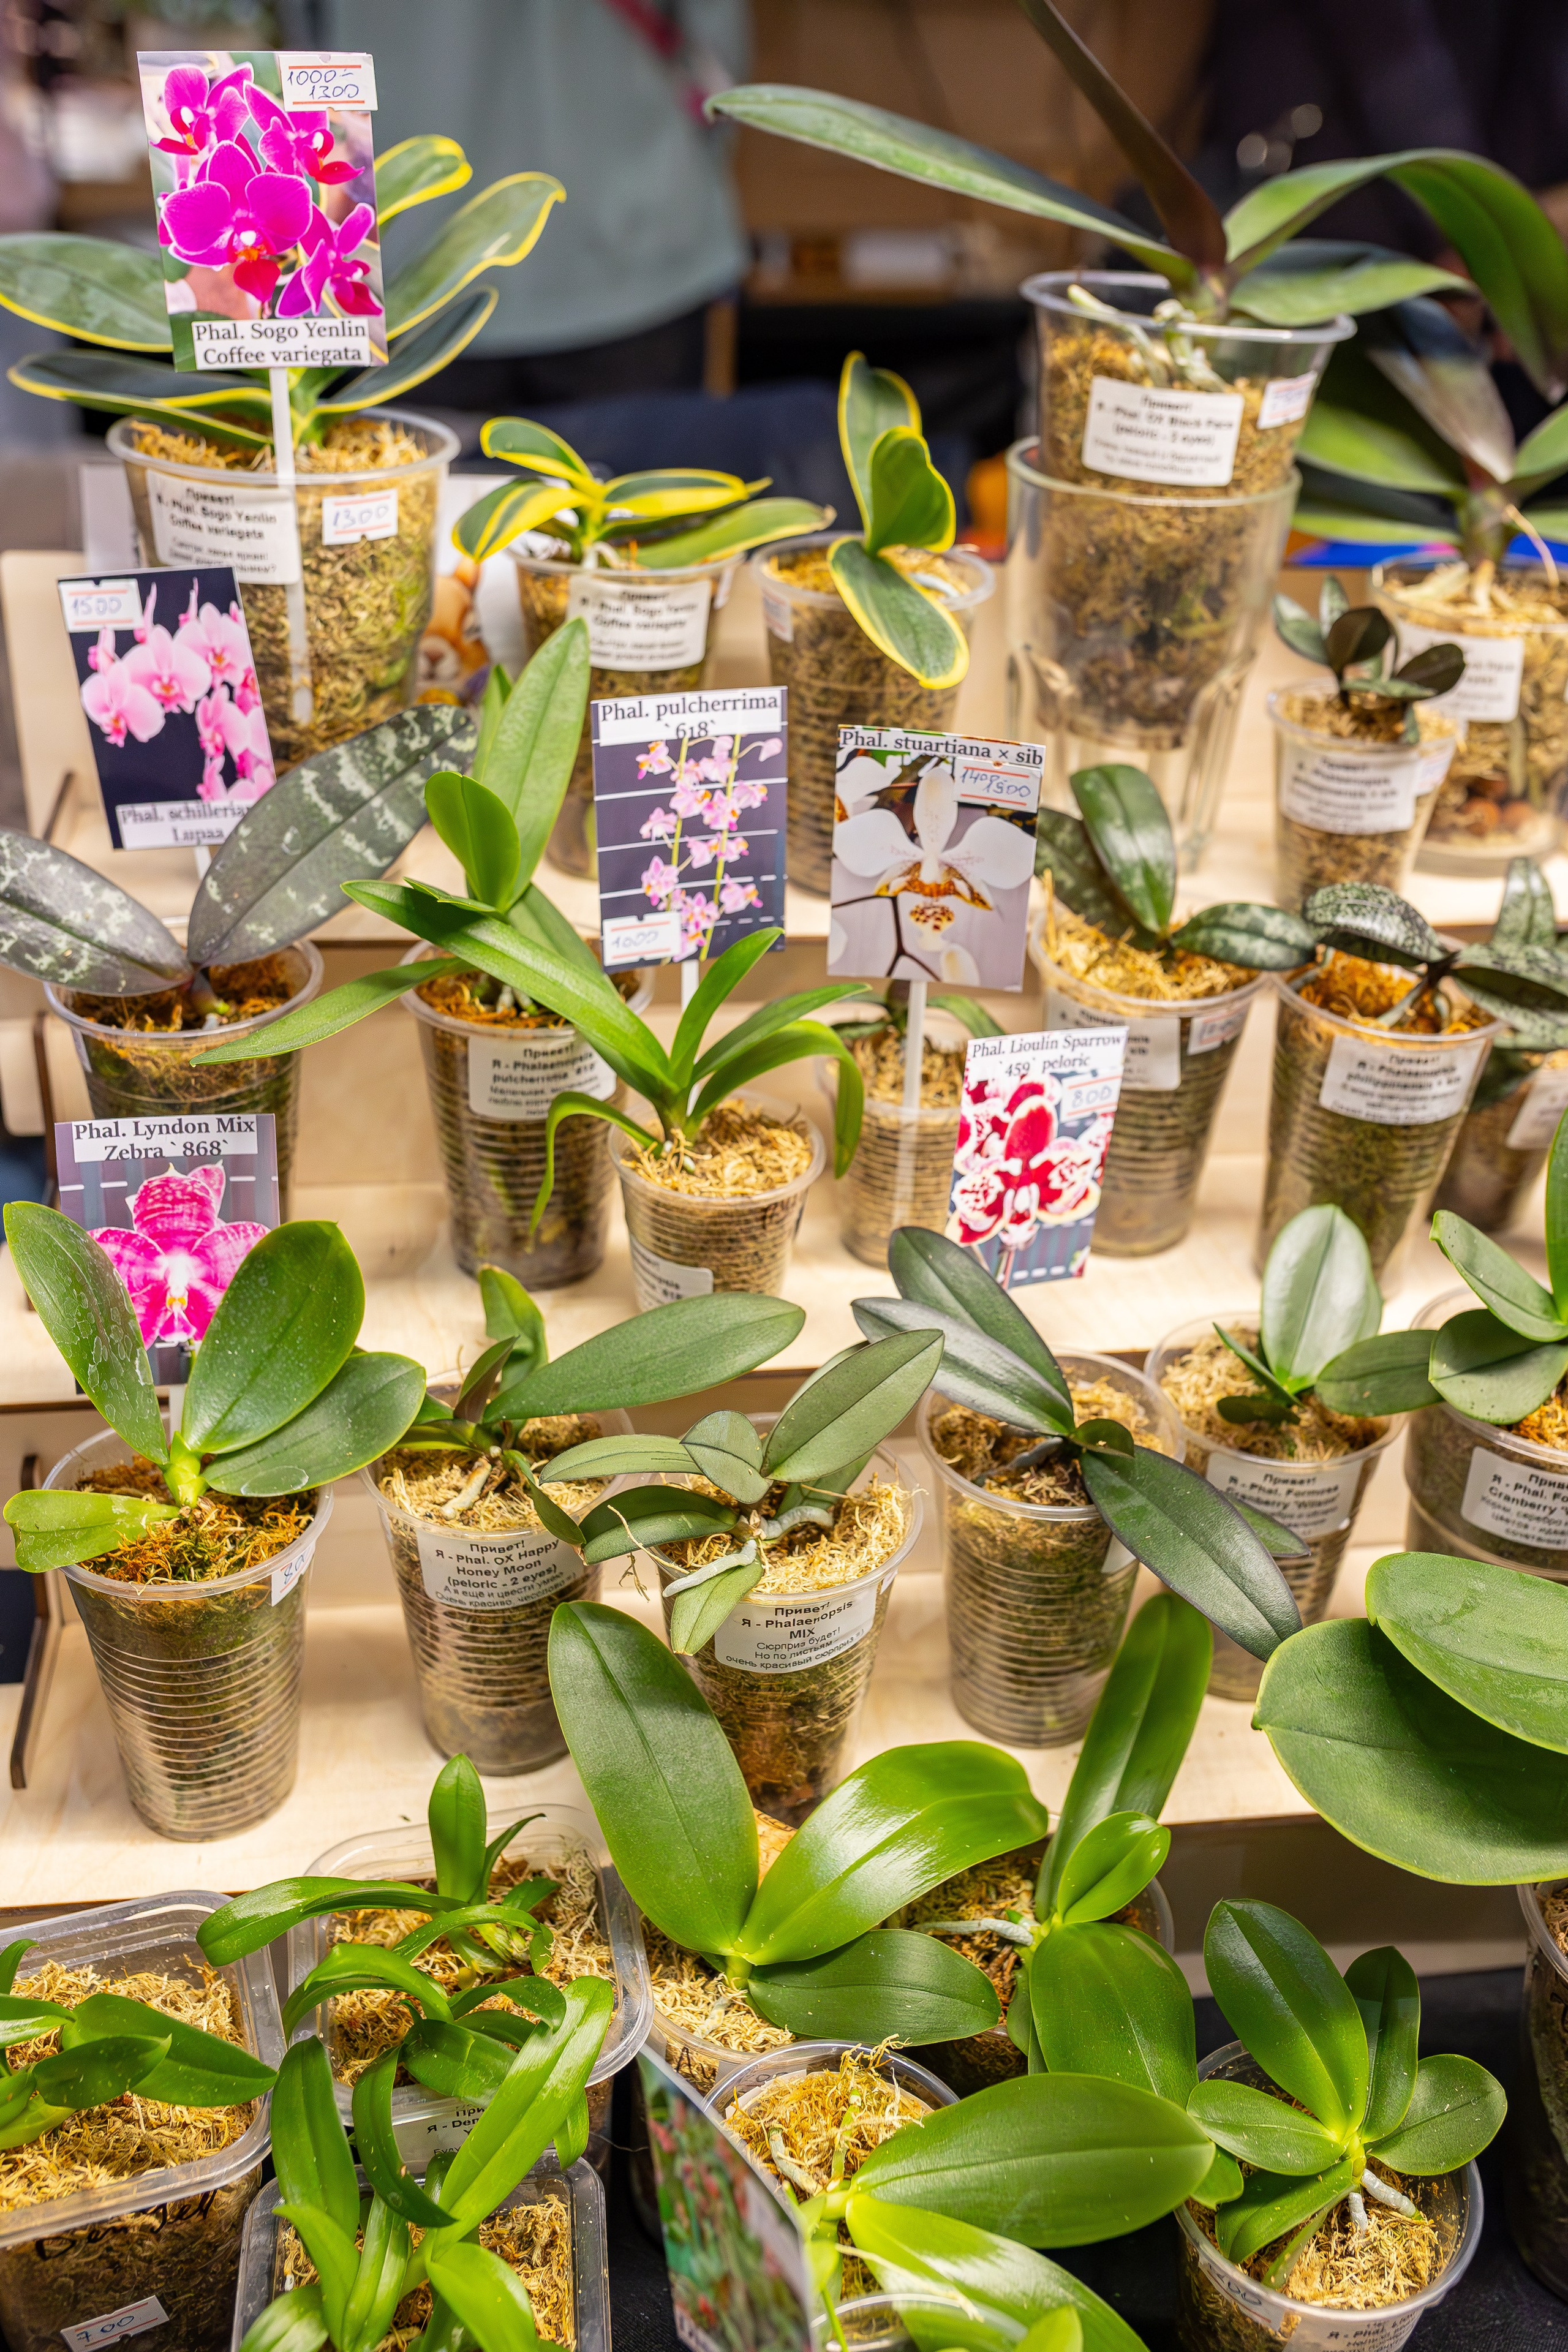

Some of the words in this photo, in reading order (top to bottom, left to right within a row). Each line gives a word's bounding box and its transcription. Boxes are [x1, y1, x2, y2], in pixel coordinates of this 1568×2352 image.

[309, 84, 359, 100] 1300
[195, 323, 244, 341] Phal.
[251, 322, 298, 343] Sogo
[306, 320, 366, 337] Yenlin
[204, 346, 265, 365] Coffee
[271, 345, 361, 366] variegata
[333, 503, 389, 529] 1300
[72, 595, 122, 616] 1500
[600, 700, 649, 722] Phal.
[656, 692, 778, 721] pulcherrima
[841, 730, 888, 747] Phal.
[894, 736, 991, 759] stuartiana
[1016, 747, 1043, 765] sib
[168, 800, 249, 821] schilleria
[972, 1039, 1005, 1058] Phal.
[1062, 1035, 1122, 1052] Sparrow
[1042, 1053, 1091, 1074] peloric
[1071, 1085, 1113, 1109] 800
[74, 1120, 126, 1140] Phal.
[133, 1118, 211, 1140] Lyndon
[216, 1115, 256, 1133] Mix
[104, 1144, 166, 1162] Zebra
[1528, 1473, 1568, 1490] Прив
[435, 1549, 445, 1559] Я
[456, 1554, 490, 1565] Phal.
[494, 1554, 514, 1566] OX
[518, 1539, 559, 1560] Happy
[470, 1540, 526, 1555] Привет!
[456, 1566, 500, 1578] Honey
[503, 1559, 542, 1575] Moon
[510, 1577, 520, 1586] 2
[741, 1618, 752, 1628] Я
[765, 1600, 854, 1629] Phalaenopsis
[774, 1600, 831, 1618] Привет!
[756, 1640, 806, 1652] Сюрприз
[808, 1626, 841, 1646] будет!
[790, 1627, 815, 1640] MIX
[755, 1651, 771, 1660] Но
[788, 1640, 833, 1660] листьям
[725, 1655, 758, 1668] очень
[760, 1655, 813, 1670] красивый
[426, 2124, 437, 2135] Я
[75, 2315, 135, 2343] 700
